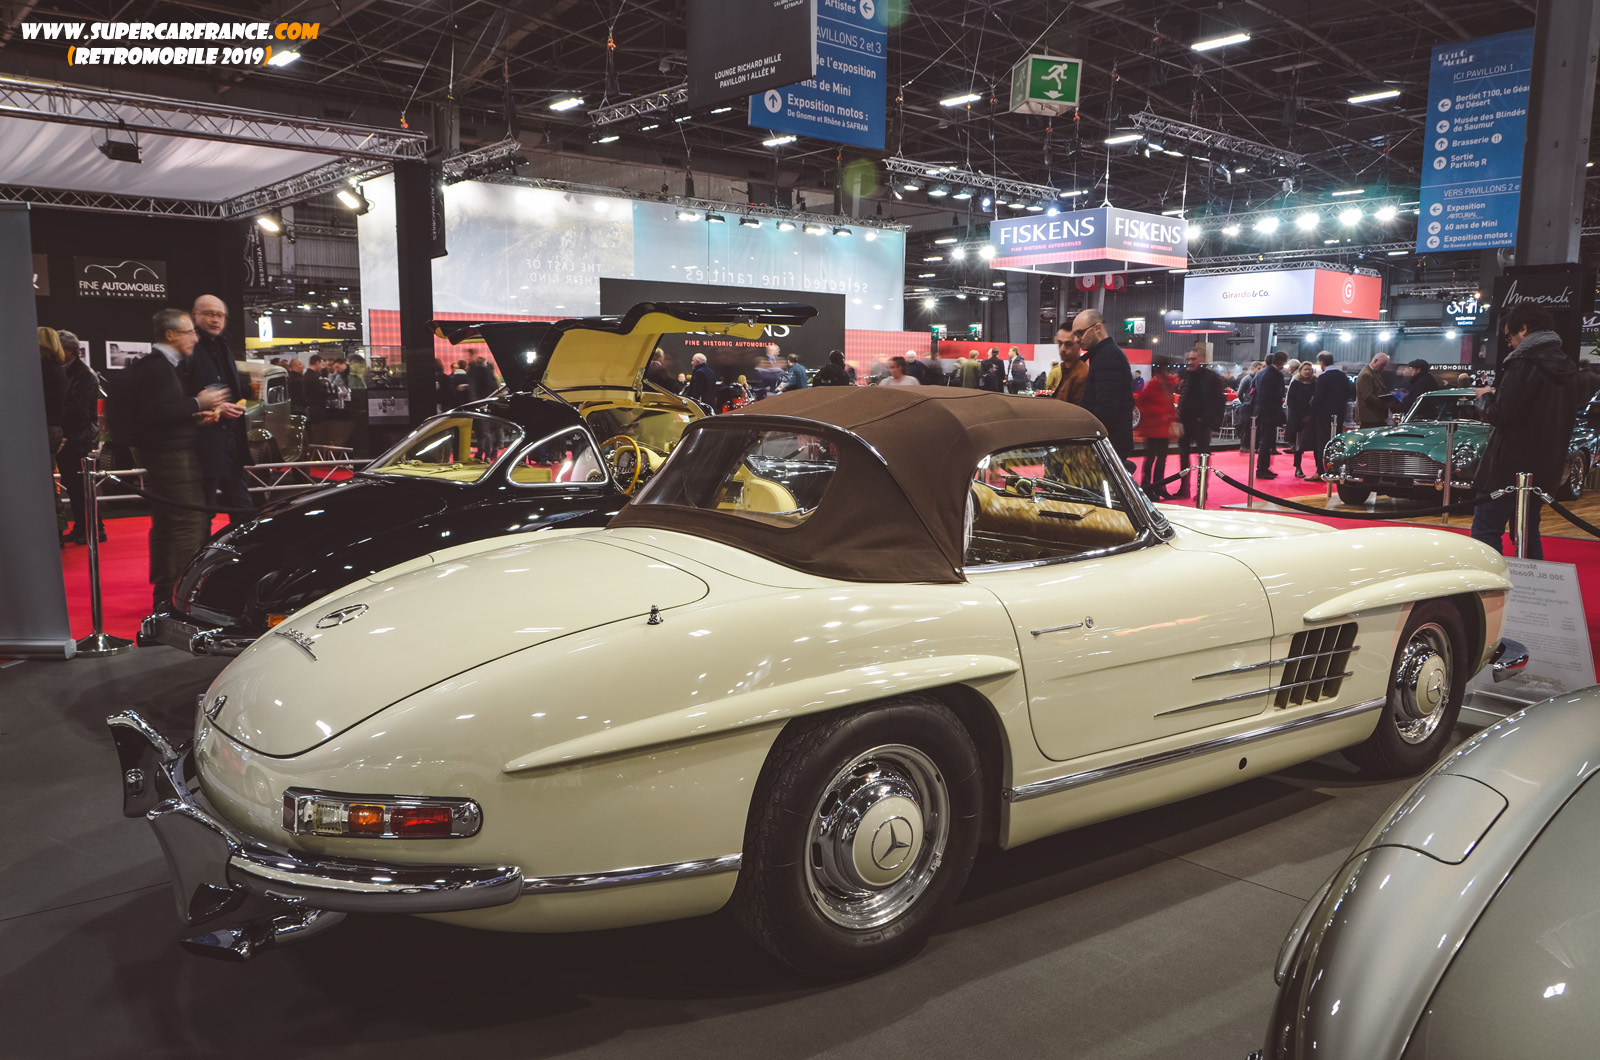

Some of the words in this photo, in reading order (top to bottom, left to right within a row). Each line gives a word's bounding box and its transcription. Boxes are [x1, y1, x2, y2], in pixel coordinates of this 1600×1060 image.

[816, 26, 858, 48] AVILLONS
[860, 38, 865, 49] 2
[866, 41, 874, 52] et
[876, 42, 882, 54] 3
[714, 67, 736, 80] LOUNGE
[737, 59, 763, 74] RICHARD
[764, 53, 782, 65] MILLE
[826, 56, 876, 79] l'exposition
[1453, 72, 1464, 81] ICI
[1466, 64, 1507, 78] PAVILLON
[720, 75, 746, 88] PAVILLON
[750, 67, 770, 80] ALLÉE
[770, 66, 776, 74] M
[800, 79, 818, 88] ans
[820, 80, 830, 92] de
[832, 82, 851, 96] Mini
[1456, 92, 1480, 102] Berliet
[1482, 88, 1502, 98] T100,
[1504, 86, 1512, 95] le
[787, 93, 835, 114] Exposition
[836, 106, 864, 120] motos
[1466, 98, 1490, 109] Désert
[787, 108, 796, 117] De
[796, 110, 816, 122] Gnome
[824, 116, 841, 126] Rhône
[846, 120, 868, 132] SAFRAN
[1454, 114, 1479, 125] Musée
[1480, 112, 1494, 121] des
[1496, 108, 1526, 119] Blindés
[1453, 124, 1462, 132] de
[1464, 121, 1495, 131] Saumur
[1452, 136, 1490, 148] Brasserie
[1450, 154, 1474, 162] Sortie
[1450, 160, 1480, 169] Parking
[1481, 158, 1488, 166] R
[1444, 189, 1464, 197] VERS
[1464, 184, 1507, 195] PAVILLONS
[1446, 202, 1486, 212] Exposition
[1000, 216, 1095, 245] FISKENS
[1114, 217, 1182, 244] FISKENS
[1481, 220, 1498, 228] Mini
[1444, 234, 1483, 243] Exposition
[1484, 232, 1508, 240] motos
[79, 280, 100, 290] FINE
[102, 282, 166, 293] AUTOMOBILES
[1345, 284, 1352, 298] G
[1222, 291, 1252, 299] Girardo
